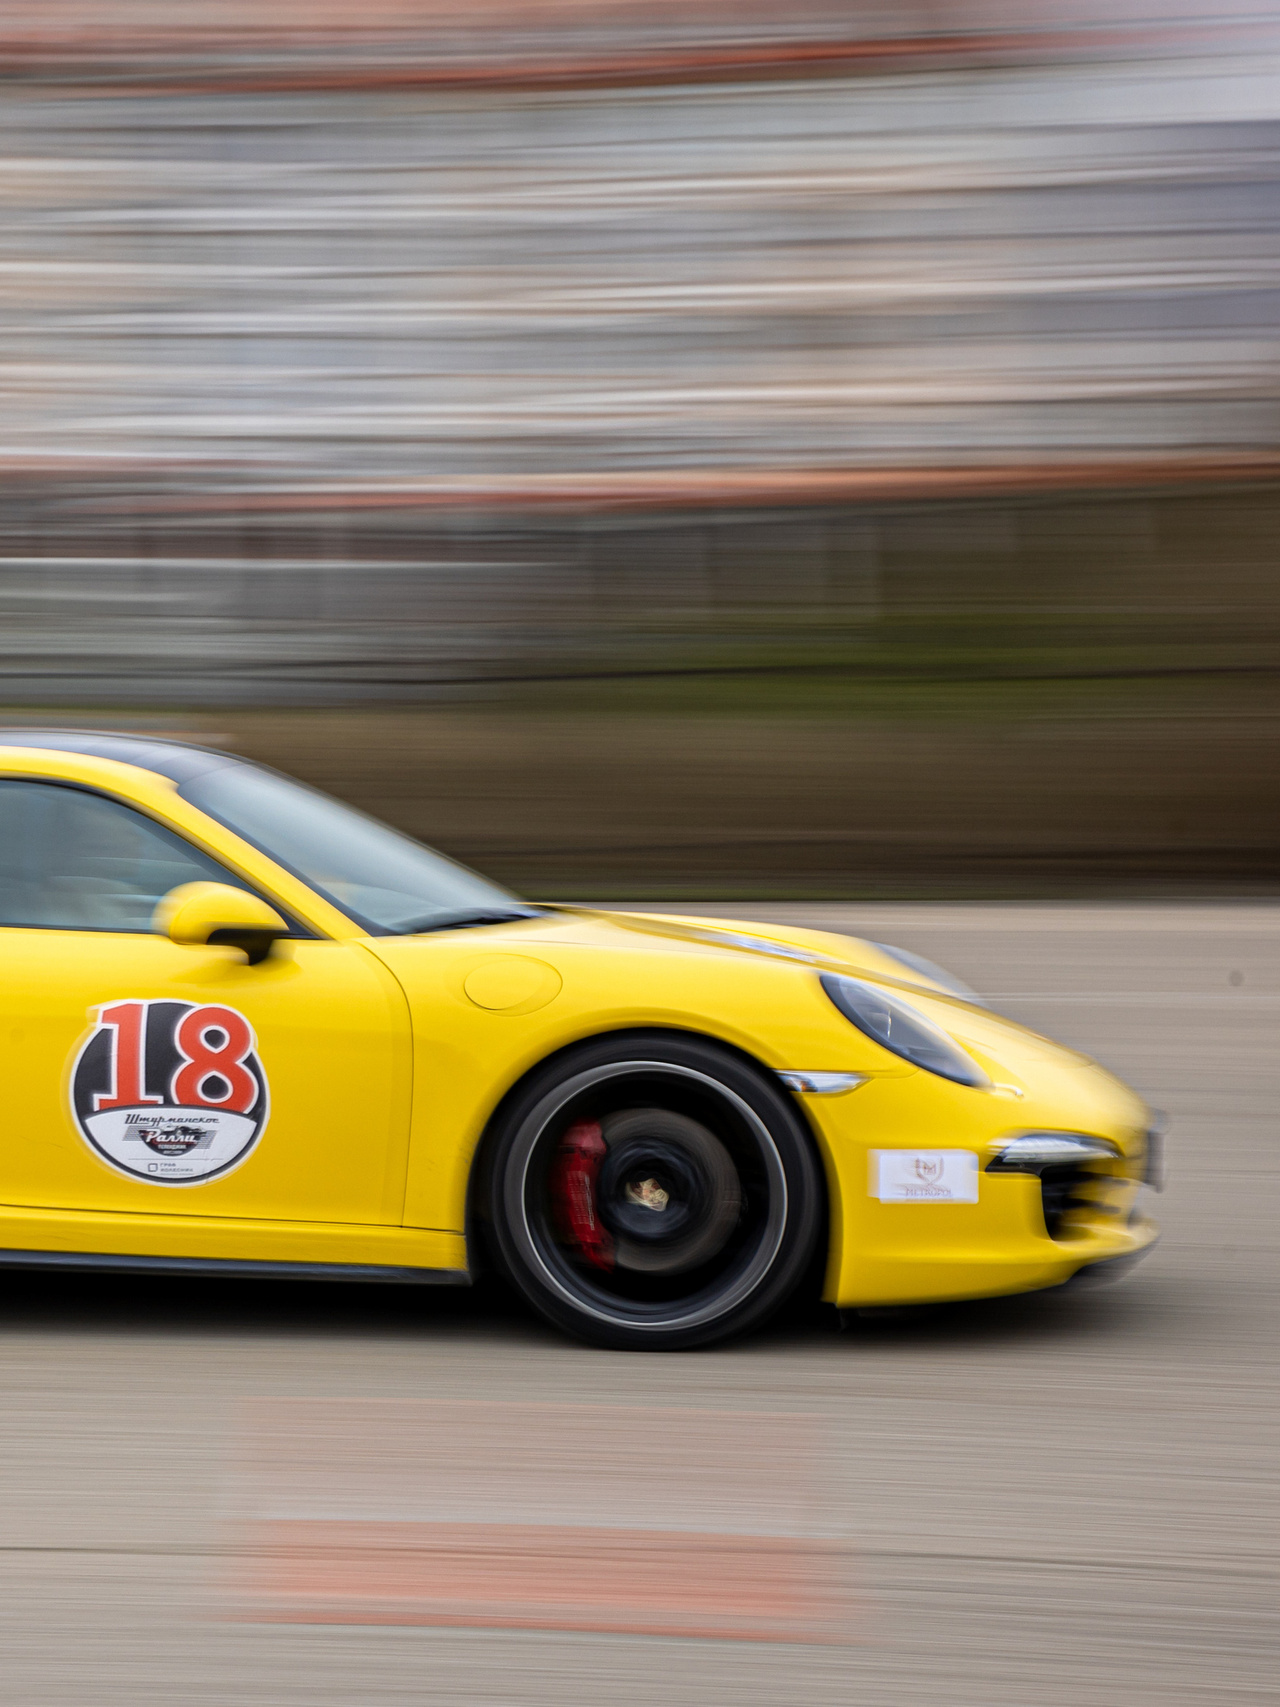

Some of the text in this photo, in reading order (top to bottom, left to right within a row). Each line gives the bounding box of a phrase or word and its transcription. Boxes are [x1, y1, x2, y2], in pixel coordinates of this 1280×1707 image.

[95, 1002, 258, 1113] 18
[124, 1113, 220, 1127] Штурманское
[145, 1128, 198, 1143] Ралли
